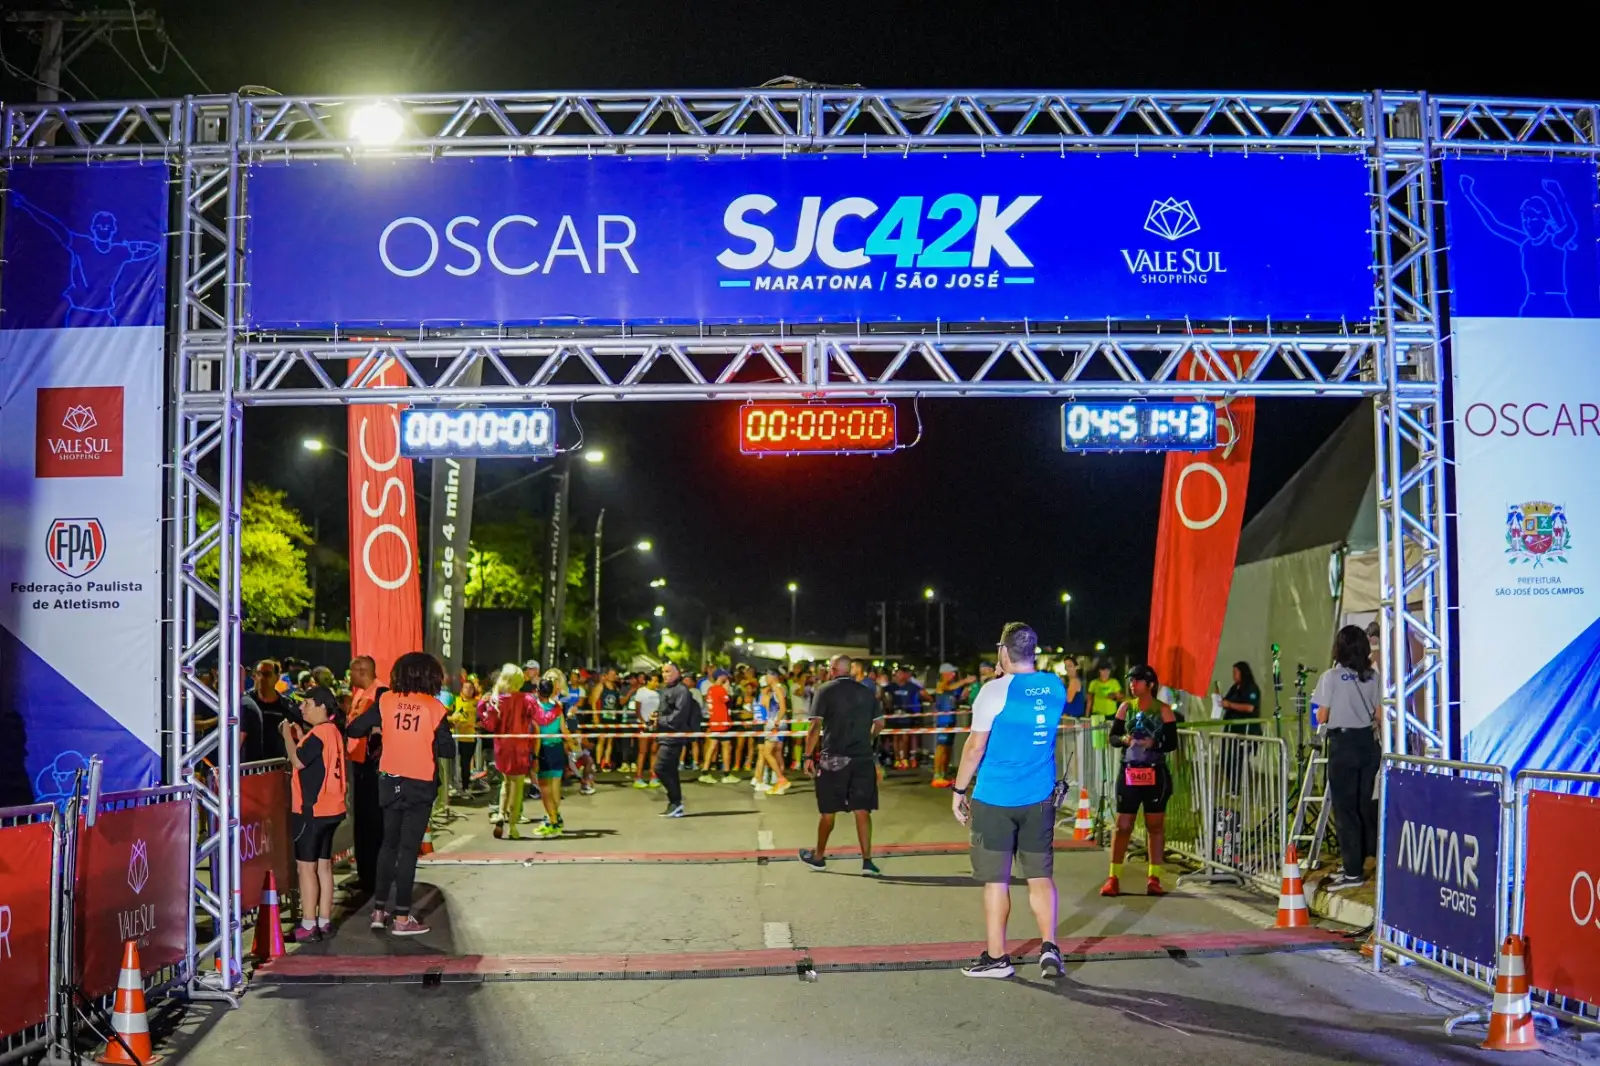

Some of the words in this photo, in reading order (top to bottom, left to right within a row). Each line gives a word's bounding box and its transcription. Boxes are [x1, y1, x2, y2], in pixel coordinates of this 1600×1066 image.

[715, 192, 1043, 270] SJC42K
[378, 214, 640, 277] OSCAR
[1120, 249, 1178, 275] VALE
[1181, 248, 1227, 275] SUL
[755, 275, 873, 291] MARATONA
[895, 272, 938, 289] SÃO
[944, 270, 1000, 288] JOSÉ
[1141, 274, 1208, 284] SHOPPING
[406, 411, 550, 447] 00:00:00
[746, 410, 888, 441] 00:00:00
[1464, 402, 1600, 437] OSCAR
[48, 438, 82, 454] VALE
[84, 436, 112, 453] SUL
[59, 453, 101, 461] SHOPPING
[442, 523, 456, 541] 4
[56, 524, 95, 568] FPA
[441, 546, 455, 579] de
[11, 581, 82, 595] Federação
[87, 581, 143, 592] Paulista
[1494, 586, 1511, 596] SÃO
[1513, 584, 1531, 596] JOSÉ
[1533, 587, 1550, 595] DOS
[1551, 587, 1585, 595] CAMPOS
[1517, 576, 1562, 585] PREFEITURA
[32, 599, 49, 609] de
[54, 598, 120, 609] Atletismo
[439, 584, 453, 659] acima
[1024, 686, 1051, 697] OSCAR
[397, 702, 421, 711] STAFF
[393, 712, 420, 732] 151
[1397, 819, 1480, 891] AVATAR
[1439, 887, 1477, 918] SPORTS
